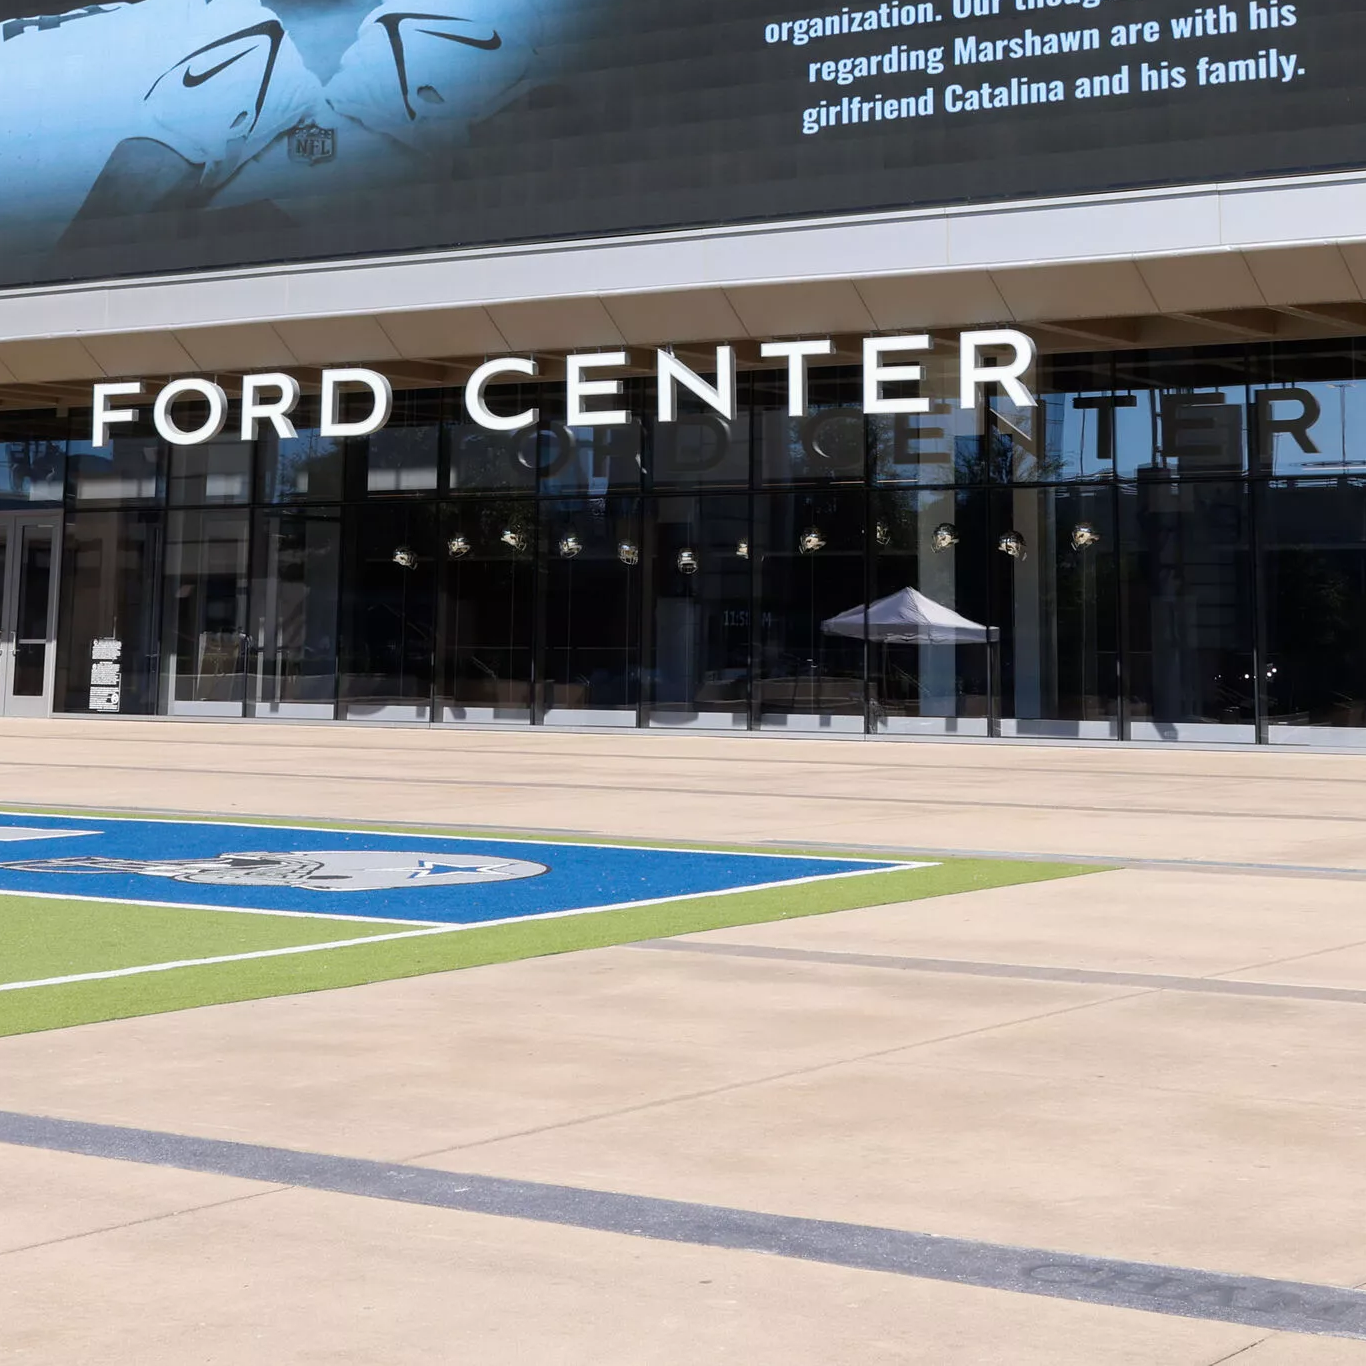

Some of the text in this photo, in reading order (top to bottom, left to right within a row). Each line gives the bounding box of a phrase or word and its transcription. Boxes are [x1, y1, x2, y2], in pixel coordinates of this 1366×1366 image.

[765, 1, 942, 45] organization.
[809, 0, 1296, 85] regarding Marshawn are with his
[803, 49, 1305, 134] girlfriend Catalina and his family.
[91, 329, 1037, 447] FORD CENTER
